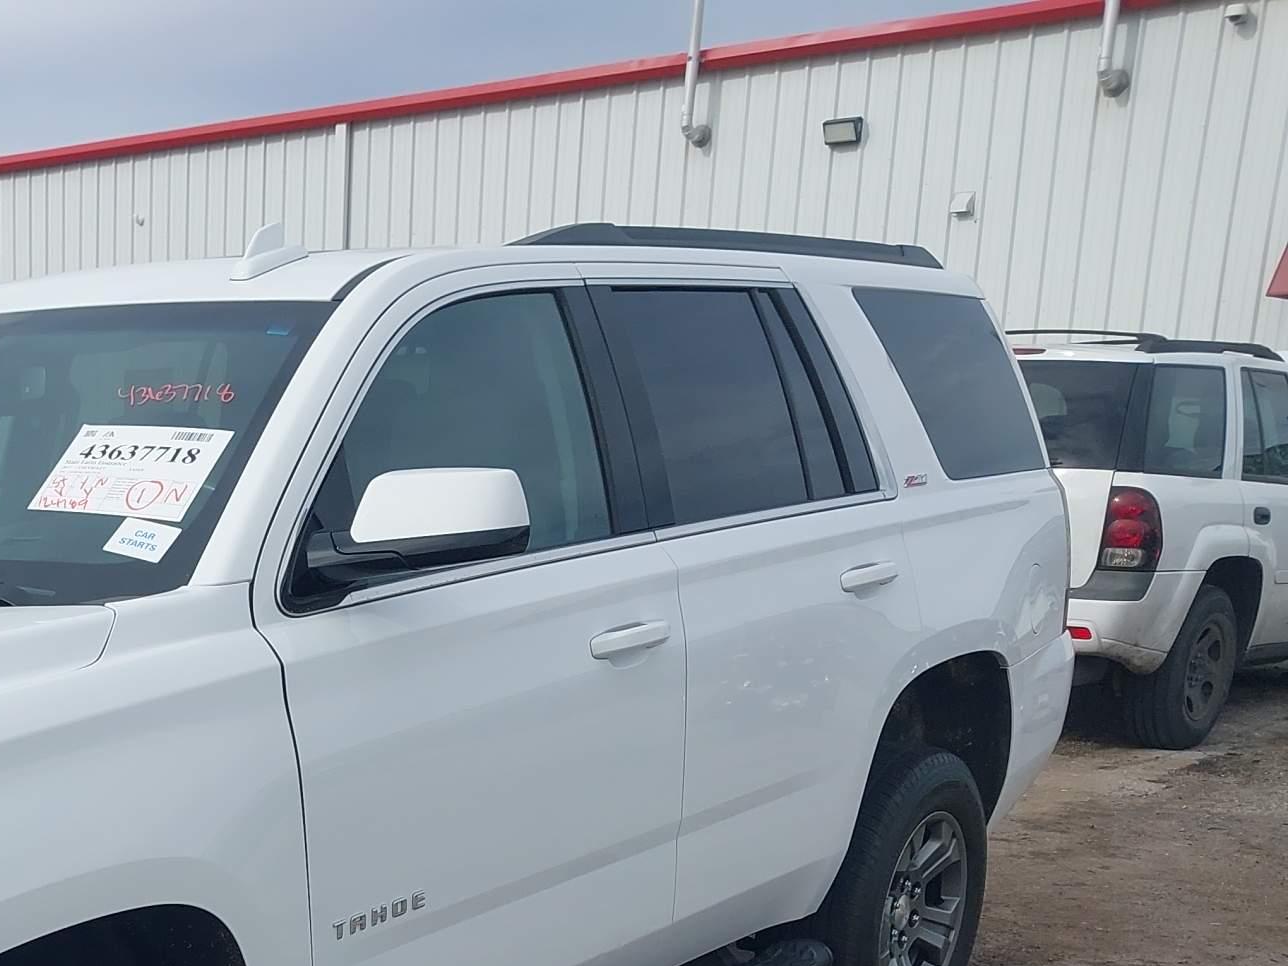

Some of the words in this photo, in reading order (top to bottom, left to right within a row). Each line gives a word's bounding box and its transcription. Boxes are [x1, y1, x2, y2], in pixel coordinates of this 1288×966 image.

[79, 444, 201, 464] 43637718
[134, 530, 156, 540] CAR
[118, 537, 158, 552] STARTS
[332, 890, 426, 941] TAHOE
